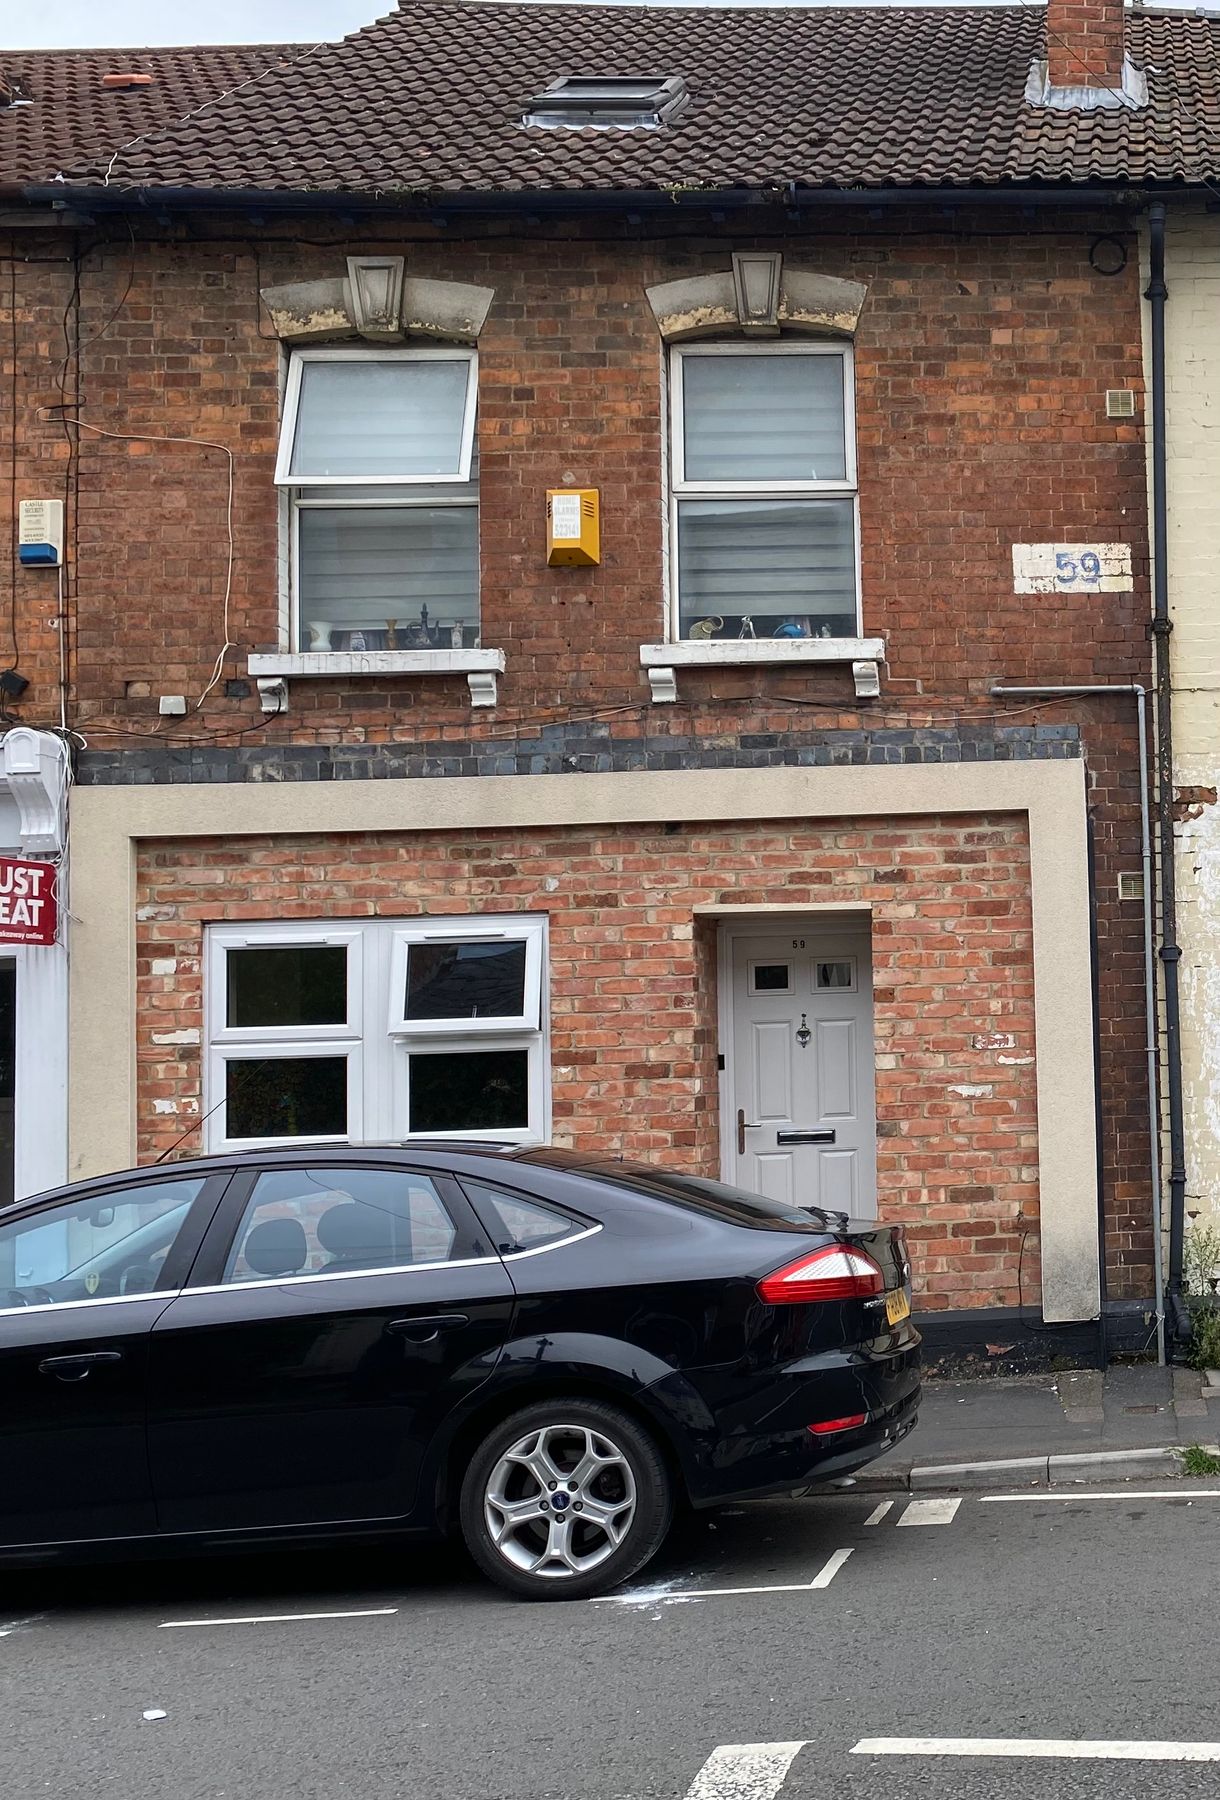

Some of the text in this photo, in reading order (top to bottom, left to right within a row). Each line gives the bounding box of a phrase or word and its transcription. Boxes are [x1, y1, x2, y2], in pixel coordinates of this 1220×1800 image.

[1055, 552, 1101, 584] 59
[0, 896, 44, 926] EAT
[25, 932, 44, 940] online
[792, 939, 805, 949] 59
